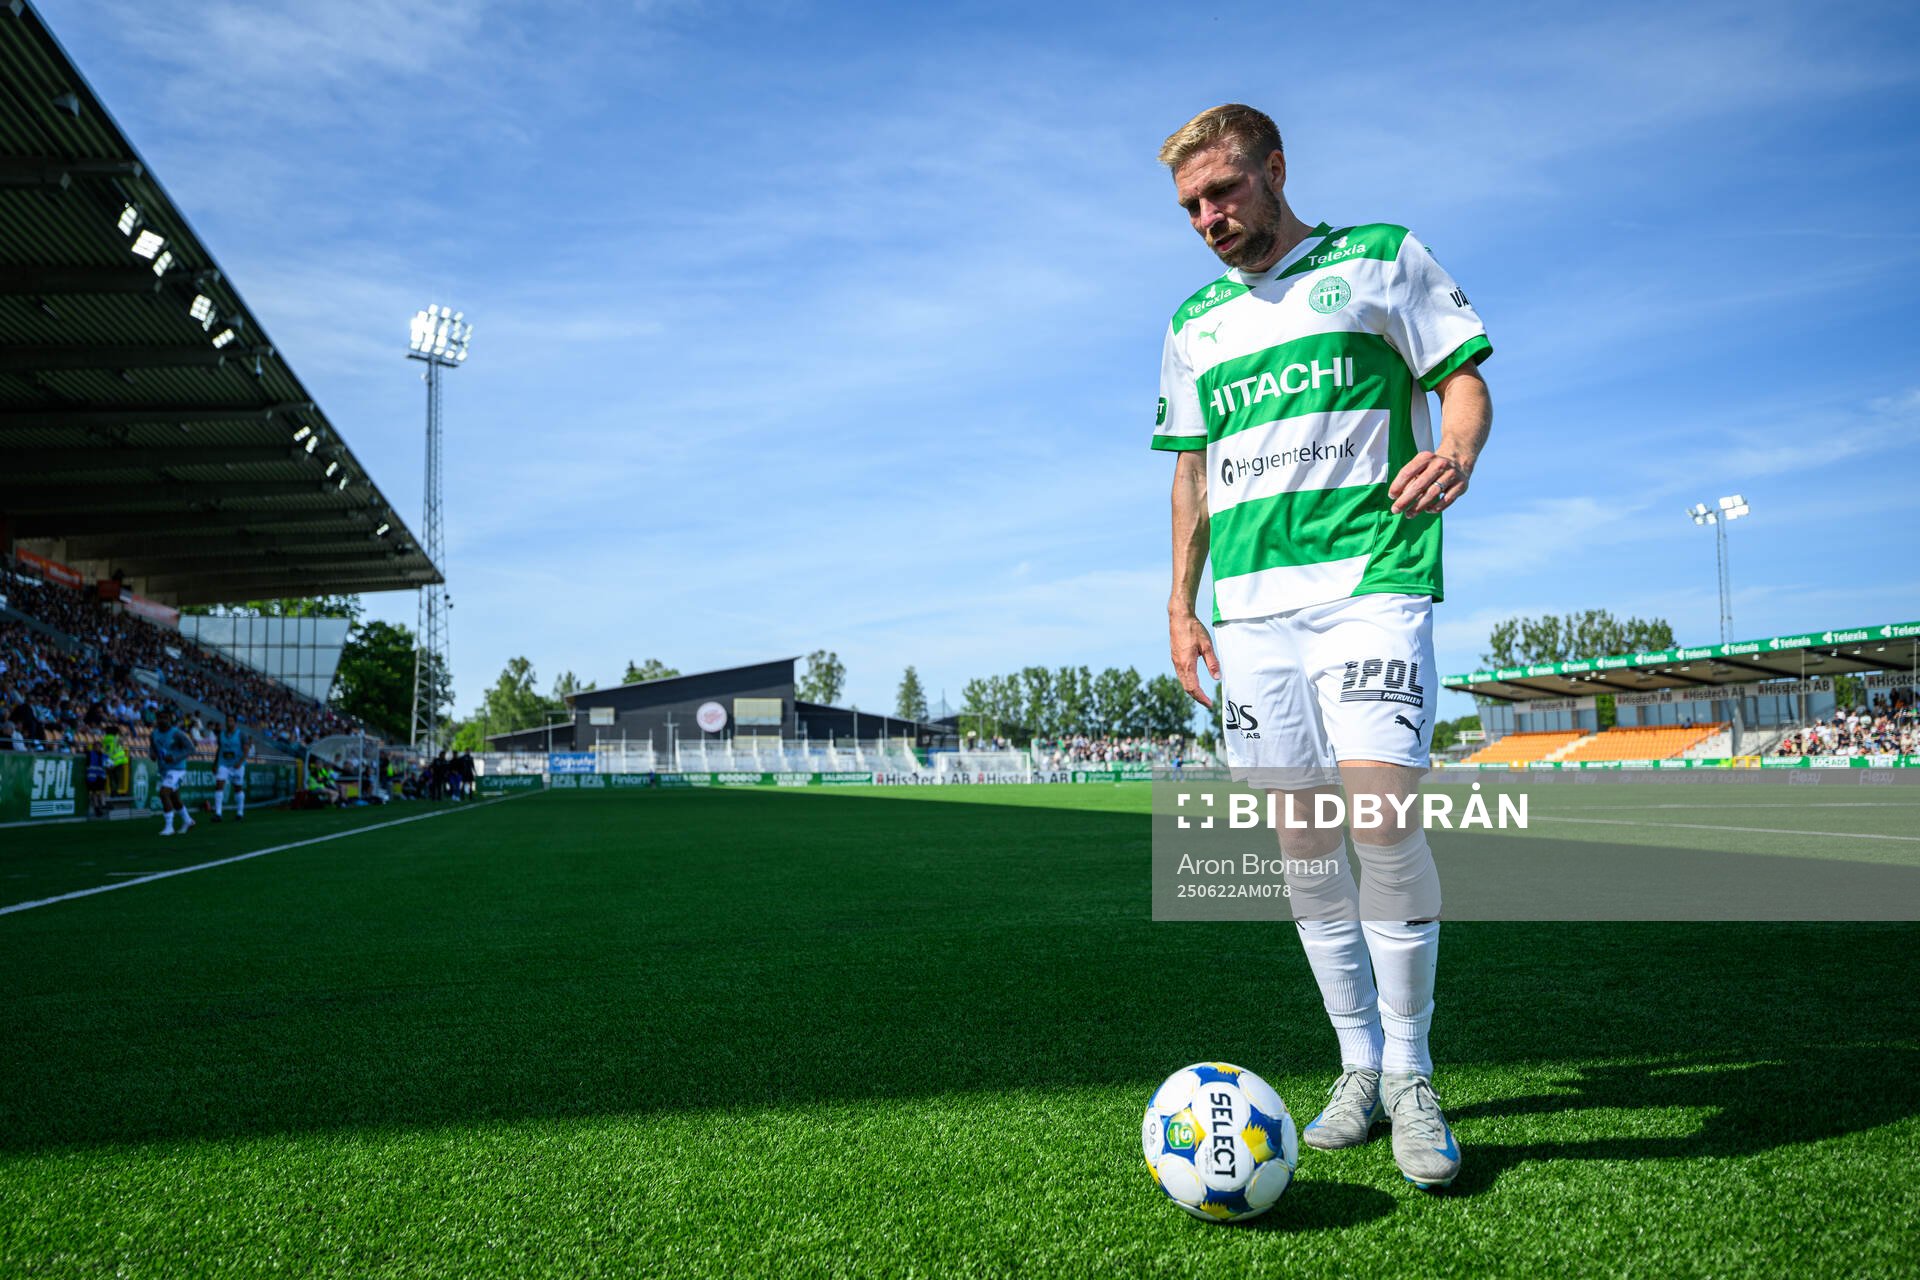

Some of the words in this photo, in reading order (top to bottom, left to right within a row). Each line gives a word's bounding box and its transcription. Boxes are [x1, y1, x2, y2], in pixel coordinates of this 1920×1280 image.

[1308, 243, 1367, 267] Telexia
[1187, 287, 1232, 316] Telexia
[1449, 286, 1472, 308] VÄ
[1210, 357, 1354, 416] HITACHI
[1236, 437, 1355, 478] Hgienteknik
[1832, 630, 1868, 643] Telexia
[1891, 625, 1920, 637] Telex
[1729, 643, 1759, 654] Telexia
[1780, 637, 1811, 649] Telexia
[1684, 648, 1711, 659] Telexia
[1342, 658, 1424, 695] SPOL
[1732, 687, 1745, 698] AB
[1814, 680, 1830, 692] AB
[1382, 692, 1422, 706] PATRULLEN
[31, 759, 75, 800] SPOL
[951, 773, 970, 785] AB
[1050, 772, 1068, 784] AB
[1789, 770, 1821, 785] Flexy
[1860, 769, 1894, 785] Flexy
[1210, 1092, 1236, 1179] SELECT
